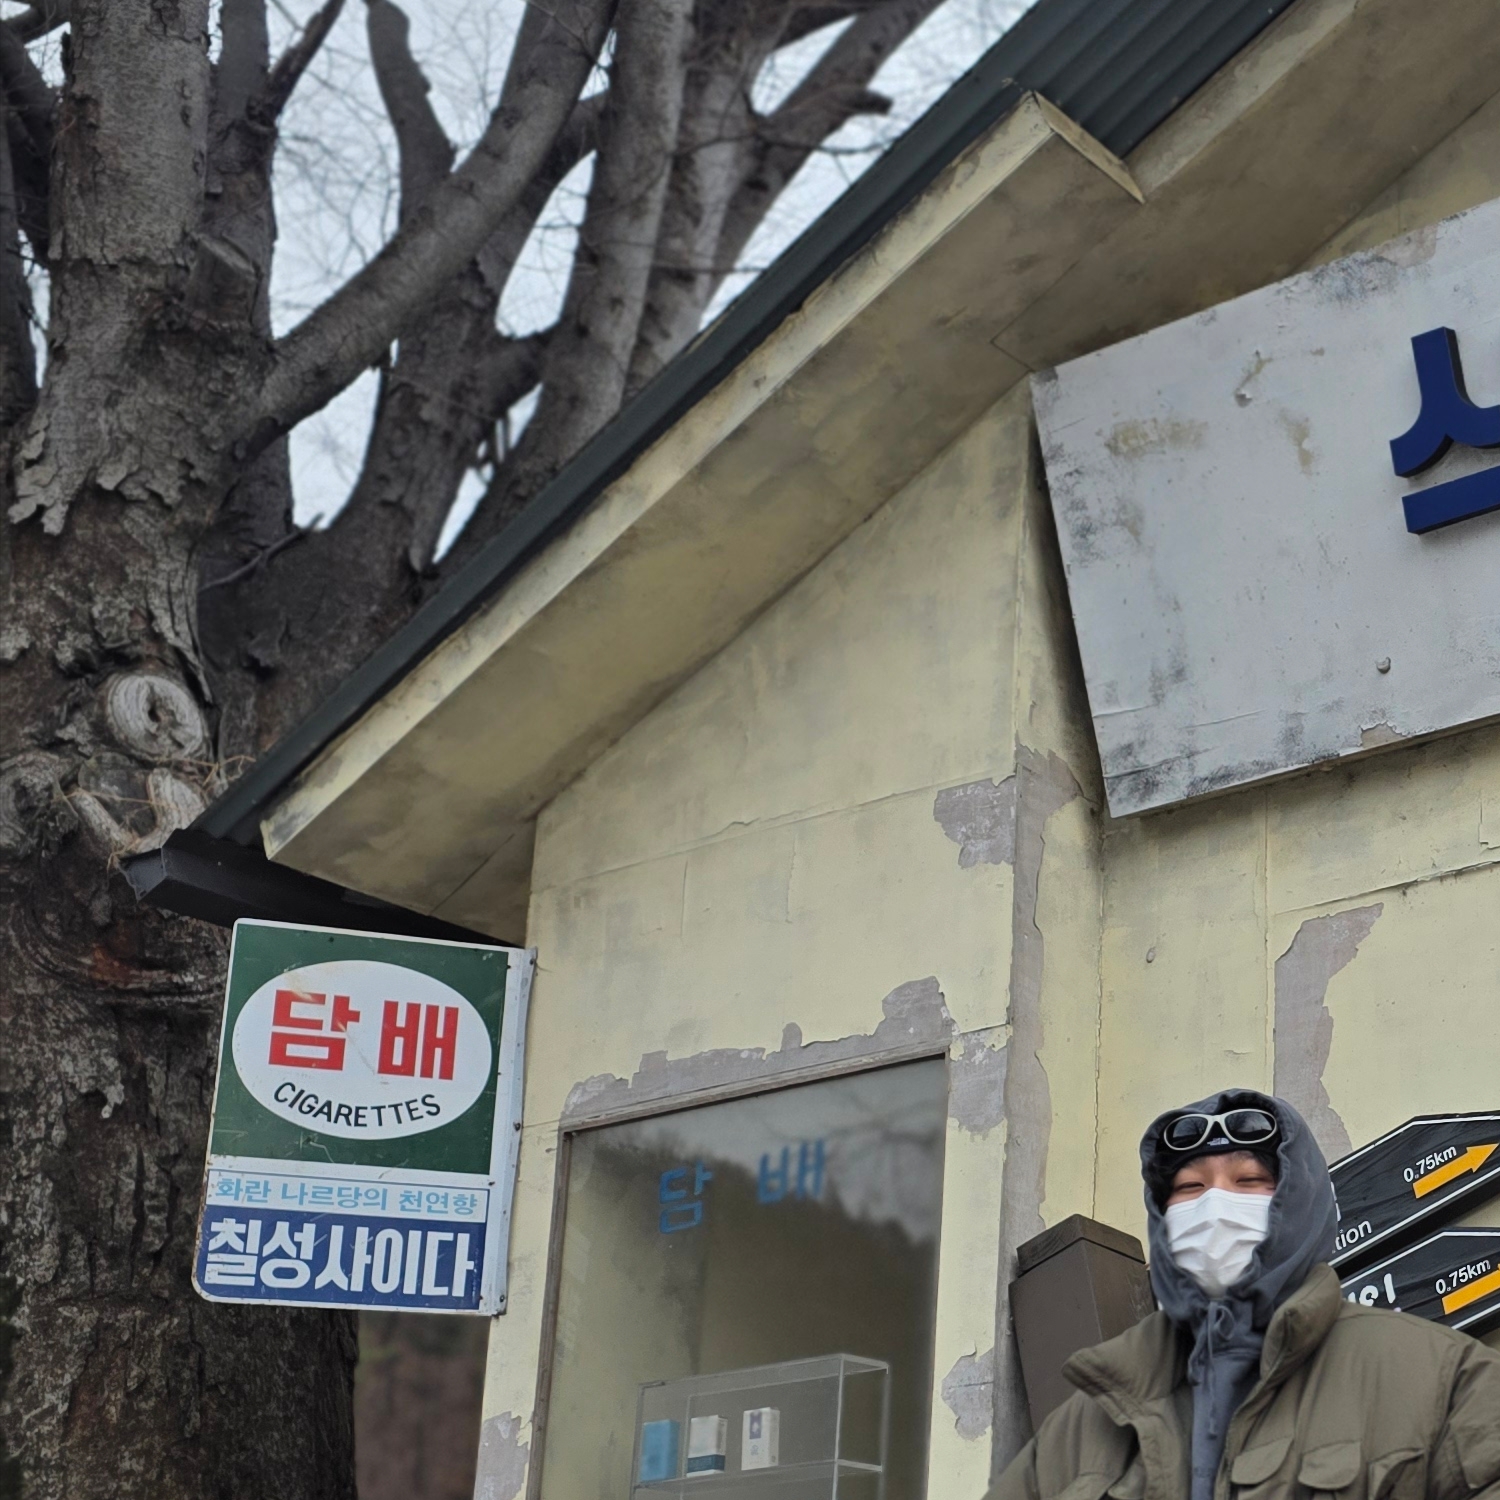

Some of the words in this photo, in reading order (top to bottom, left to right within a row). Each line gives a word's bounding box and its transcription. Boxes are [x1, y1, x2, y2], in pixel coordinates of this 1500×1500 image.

[268, 989, 459, 1081] 담배
[272, 1081, 441, 1127] CIGARETTES
[1403, 1145, 1457, 1183] 0.75km
[215, 1177, 271, 1203] 화란
[281, 1182, 388, 1211] 나르당의
[399, 1189, 478, 1216] 천연향
[1332, 1220, 1372, 1252] tion
[204, 1217, 474, 1298] 칠성사이다
[1435, 1258, 1491, 1295] 0.75km
